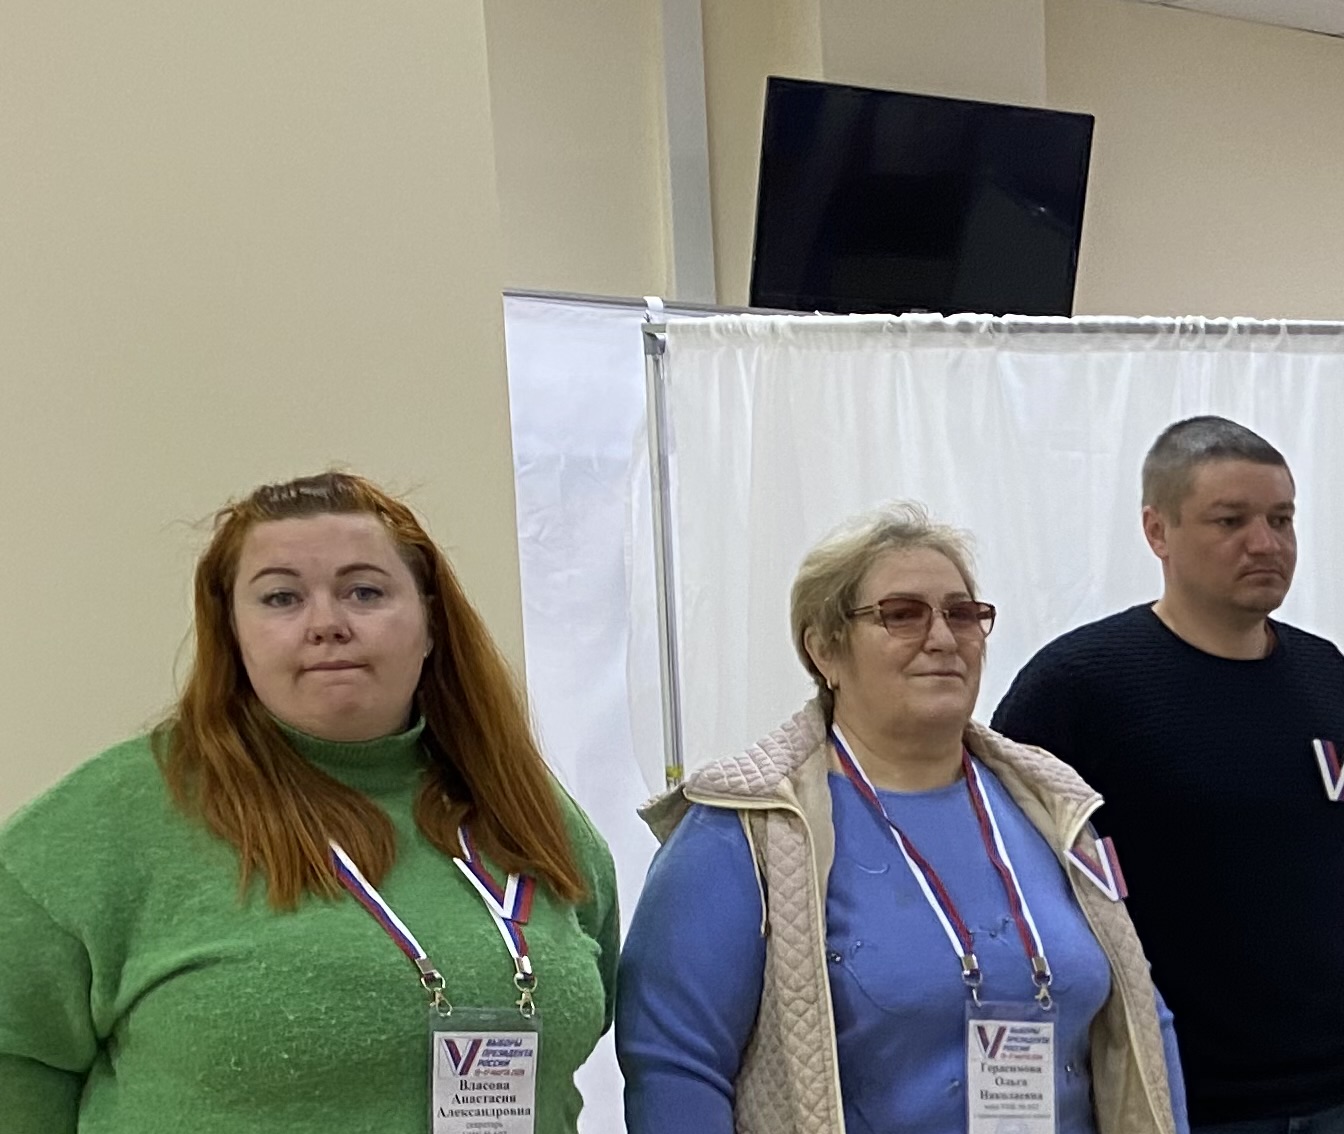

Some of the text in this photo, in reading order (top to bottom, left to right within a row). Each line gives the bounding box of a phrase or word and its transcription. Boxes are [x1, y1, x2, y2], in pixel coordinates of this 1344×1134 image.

[486, 1038, 522, 1047] ВЫБОРЫ
[482, 1049, 533, 1058] ПРЕЗИДЕНТА
[477, 1059, 510, 1067] РОССИИ
[981, 1062, 1042, 1075] Герасимова
[459, 1079, 510, 1092] Власова
[994, 1076, 1028, 1087] Ольга
[451, 1093, 517, 1105] Анастасия
[980, 1089, 1044, 1101] Николаевна
[437, 1106, 531, 1119] Александровна
